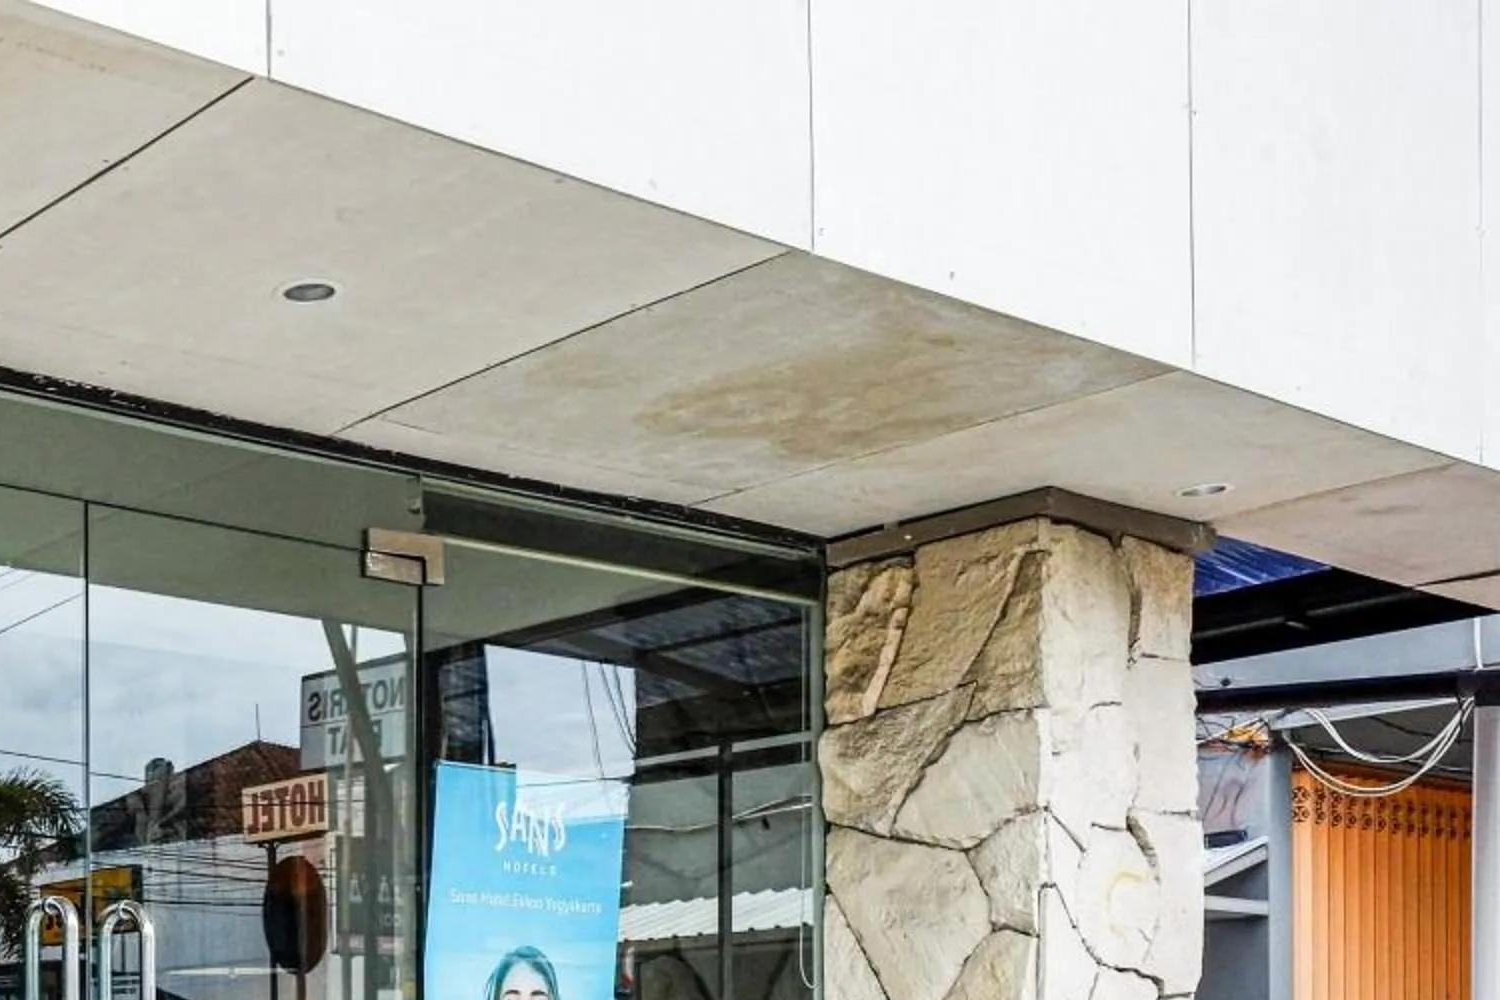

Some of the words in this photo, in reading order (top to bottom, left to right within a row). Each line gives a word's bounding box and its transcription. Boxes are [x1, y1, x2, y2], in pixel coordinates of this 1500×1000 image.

[495, 801, 567, 857] SANS
[503, 860, 557, 876] HOTELS
[546, 896, 603, 915] Yogyakarta
